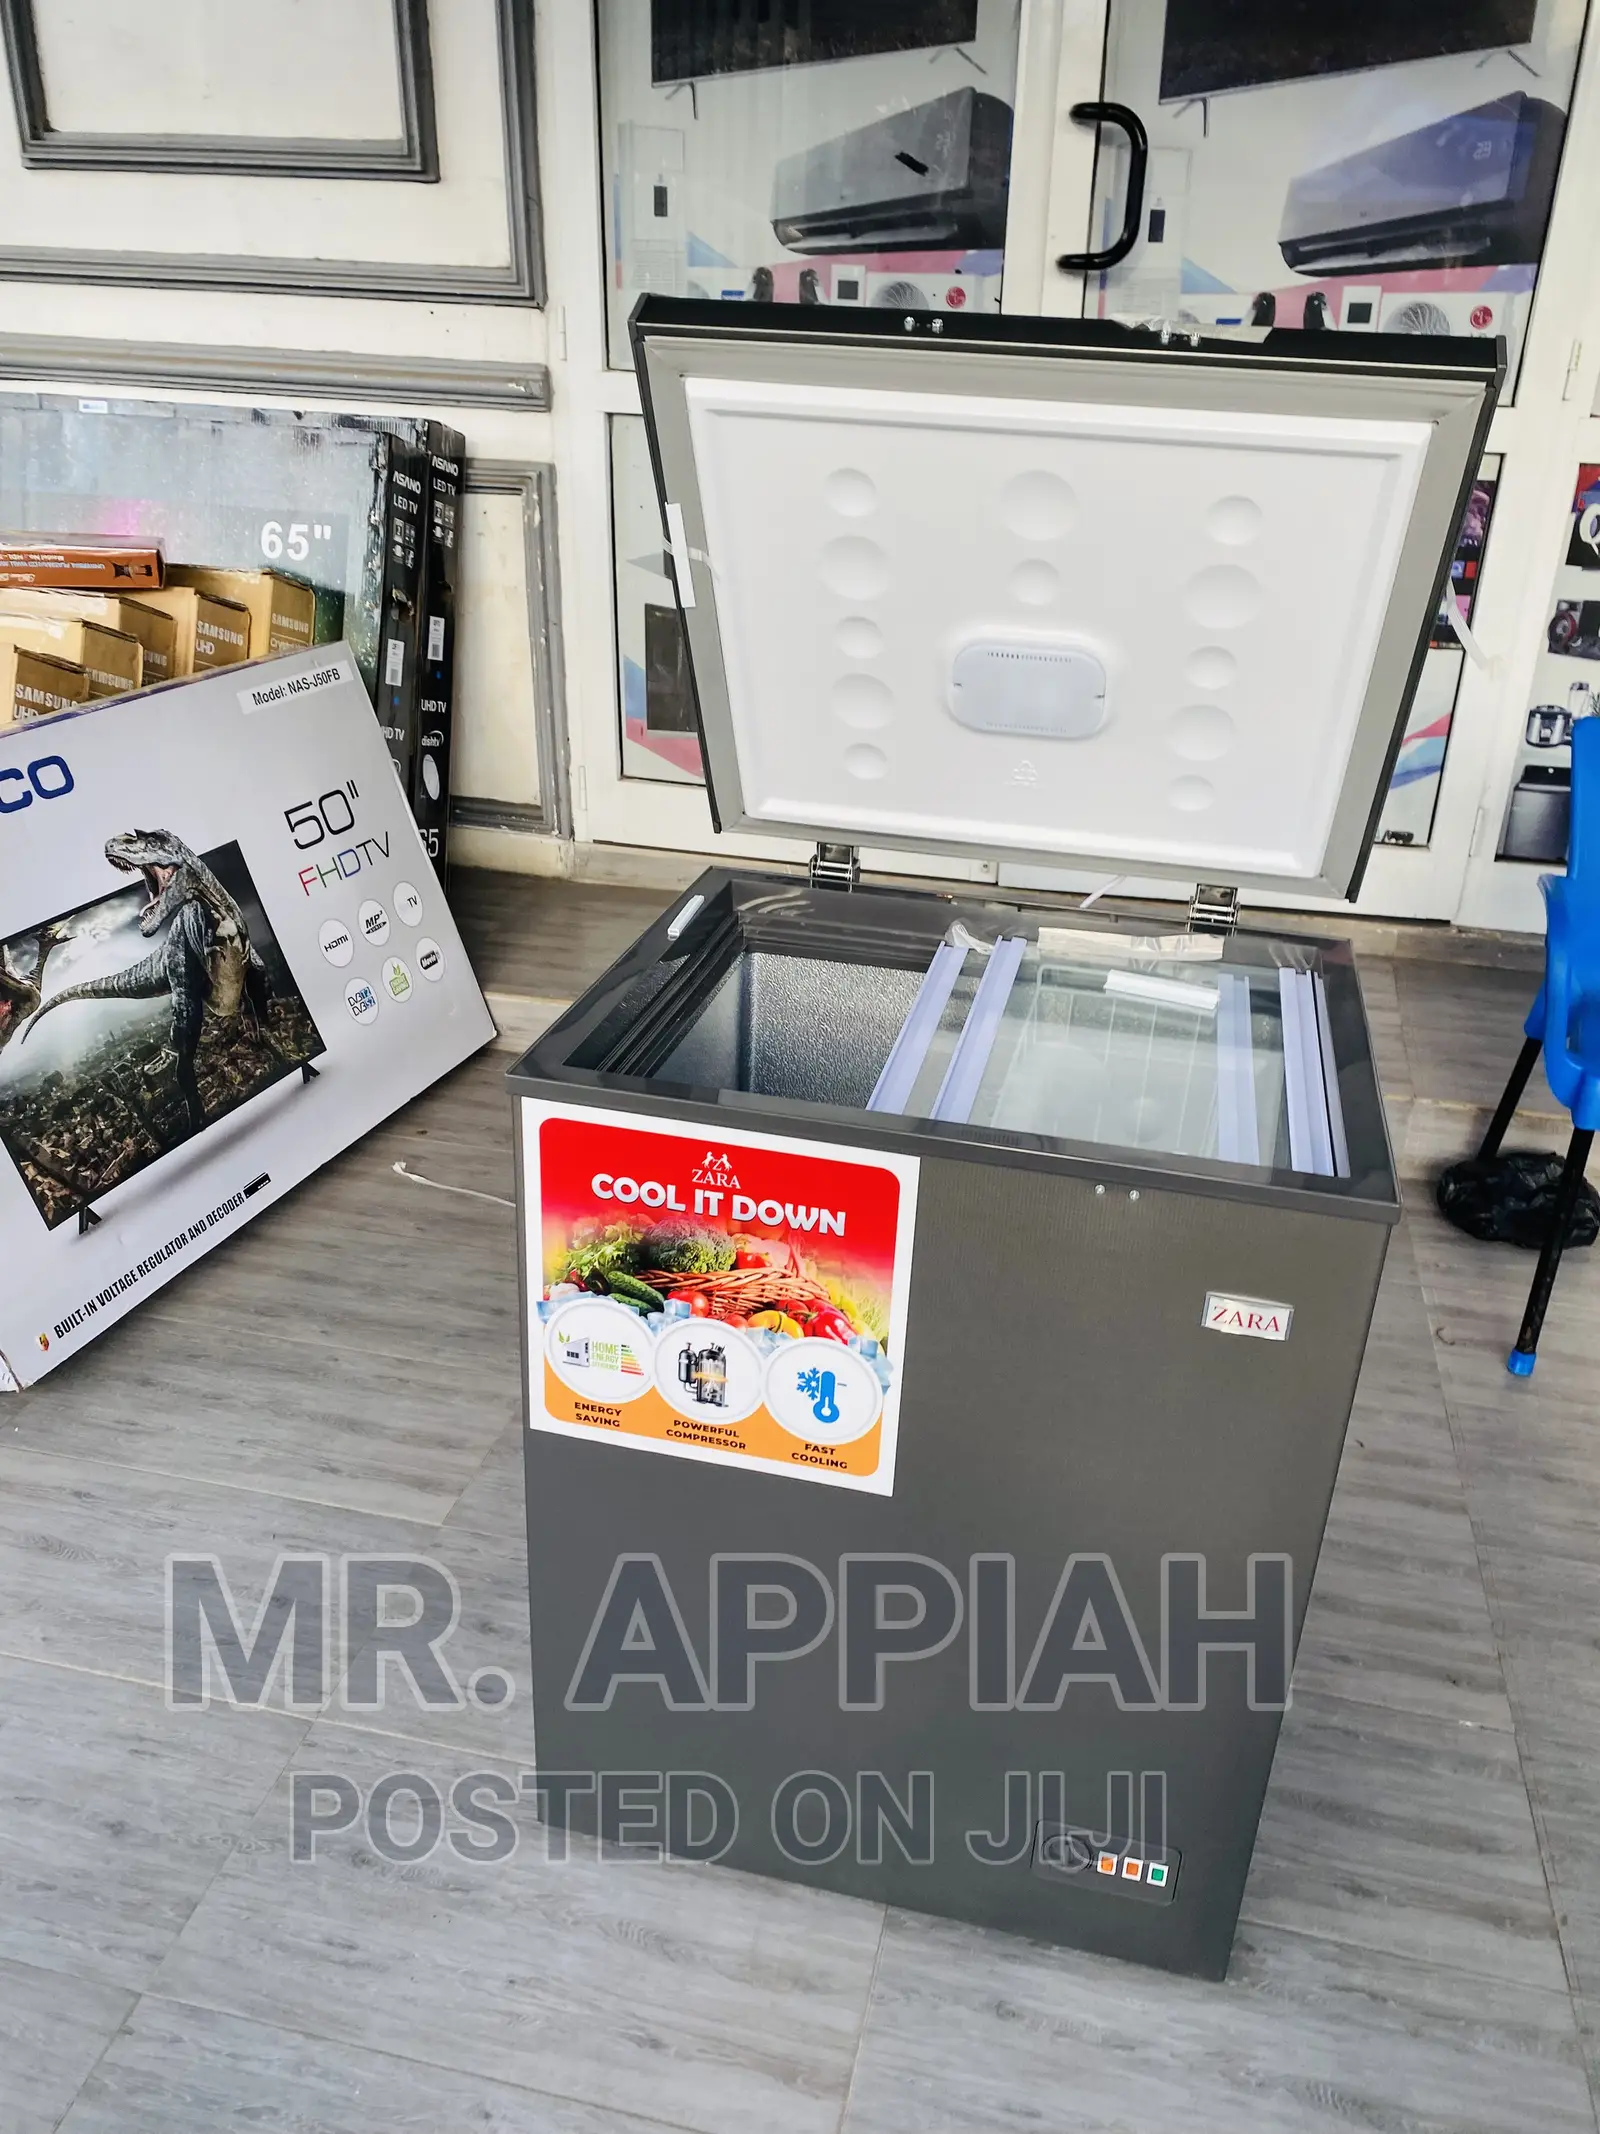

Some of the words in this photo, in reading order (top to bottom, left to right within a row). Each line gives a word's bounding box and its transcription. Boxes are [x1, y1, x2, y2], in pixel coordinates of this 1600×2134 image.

[432, 455, 459, 477] ASANO
[392, 470, 421, 494] ASANO
[433, 477, 446, 493] LED
[446, 482, 457, 497] TV
[393, 493, 408, 511] LED
[408, 501, 418, 515] TV
[260, 520, 331, 562] 65"
[197, 620, 244, 646] SAMSUNG
[271, 612, 309, 634] SAMSUNG
[196, 638, 215, 655] UHD
[252, 686, 287, 706] Model:
[287, 667, 341, 695] NAS-J50FB
[421, 698, 437, 713] UHD
[436, 701, 447, 713] TV
[393, 727, 405, 741] TV
[283, 779, 359, 850] 50"
[407, 895, 418, 908] TV
[692, 1169, 741, 1189] ZARA
[591, 1173, 686, 1212] COOL
[694, 1188, 724, 1217] IT
[731, 1194, 846, 1237] DOWN
[53, 1299, 98, 1339] BUILT-IN
[96, 1270, 139, 1307] VOLTAGE
[136, 1233, 190, 1278] REGULATOR
[187, 1219, 208, 1241] AND
[205, 1192, 246, 1233] DECODER
[1212, 1304, 1280, 1333] ZARA
[592, 1341, 619, 1356] HOME
[574, 1402, 622, 1417] ENERGY
[575, 1413, 620, 1428] SAVING
[673, 1419, 740, 1439] POWERFUL
[666, 1429, 746, 1450] COMPRESSOR
[804, 1443, 836, 1456] FAST
[791, 1452, 848, 1470] COOLING
